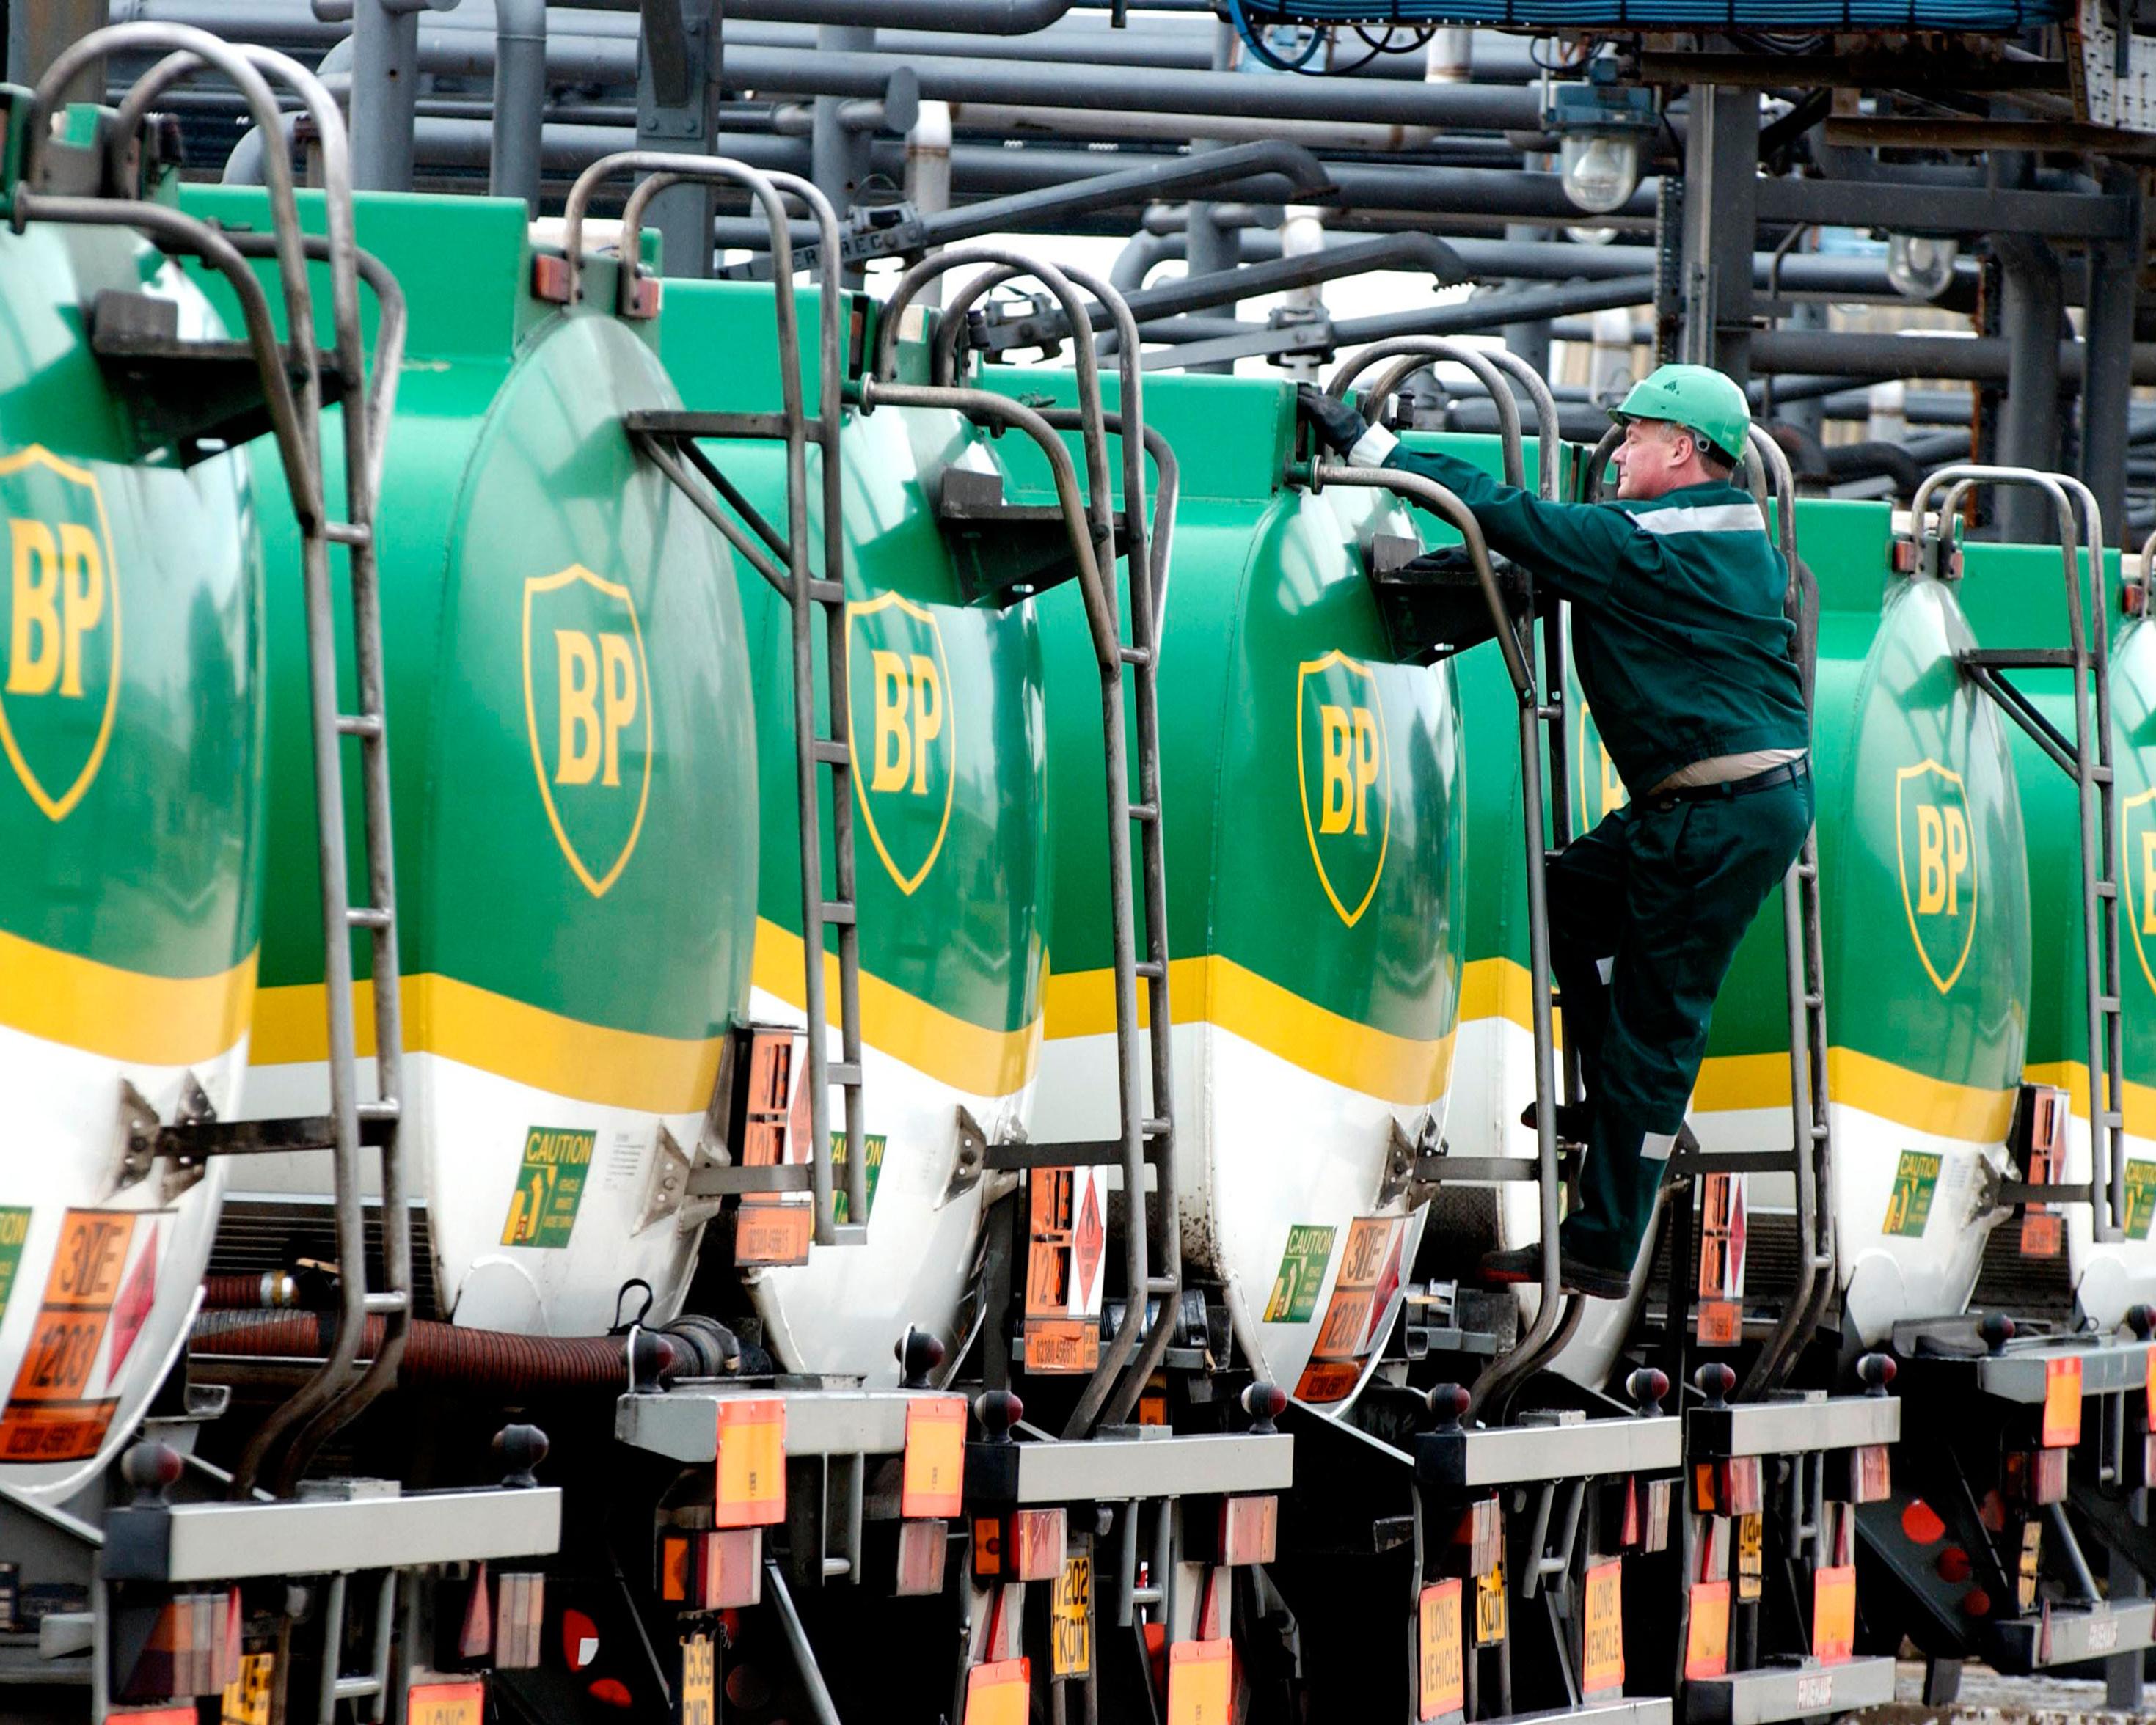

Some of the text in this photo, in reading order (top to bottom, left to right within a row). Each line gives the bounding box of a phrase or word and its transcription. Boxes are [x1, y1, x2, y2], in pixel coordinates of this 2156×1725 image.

[6, 519, 103, 697] BP
[554, 629, 637, 787] BP
[871, 650, 942, 794] BP
[1319, 705, 1379, 835] BP
[1916, 805, 1968, 915] BP
[526, 1132, 593, 1164] CAUTION
[1899, 1154, 1940, 1178] CAUTION
[1287, 1229, 1334, 1254] CAUTION
[1430, 1600, 1454, 1644] LONG
[1593, 1580, 1613, 1621] LONG
[1587, 1624, 1620, 1667] VEHICLE
[1425, 1647, 1460, 1693] VEHICLE
